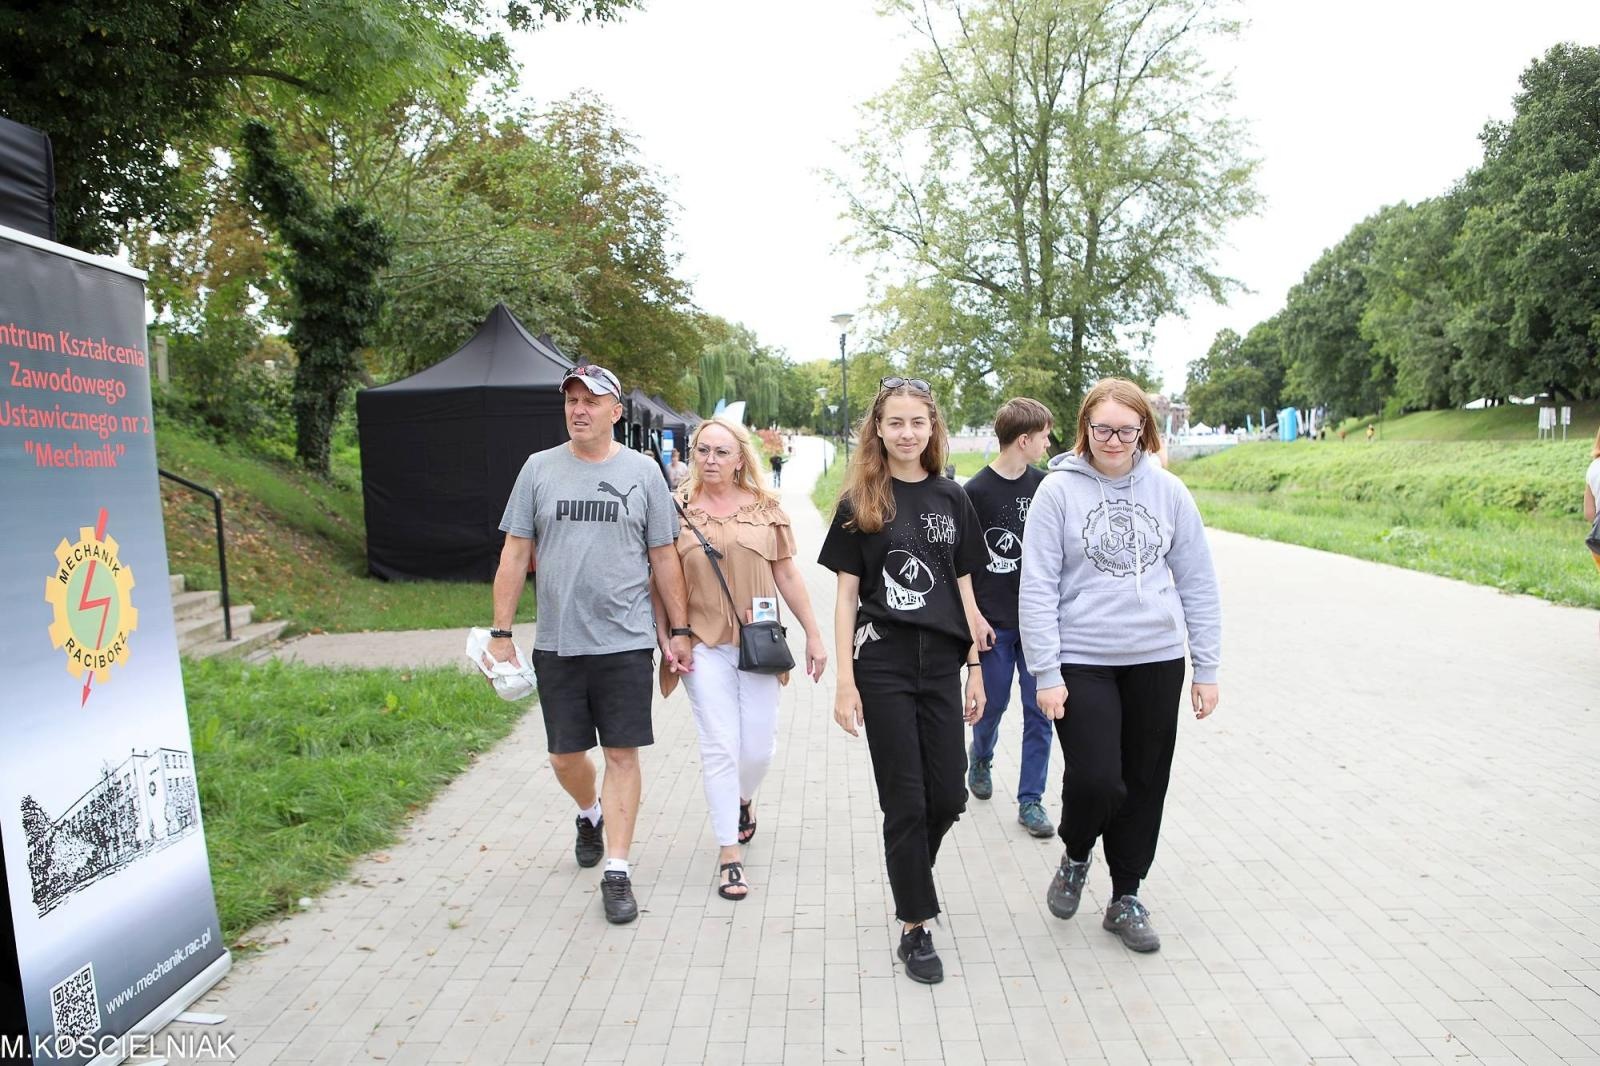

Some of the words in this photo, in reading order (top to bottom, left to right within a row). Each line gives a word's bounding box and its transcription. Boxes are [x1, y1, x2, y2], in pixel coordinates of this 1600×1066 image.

[59, 331, 145, 367] Kształcenia
[9, 361, 127, 405] Zawodowego
[0, 400, 118, 439] Ustawicznego
[122, 416, 138, 432] nr
[142, 416, 150, 434] 2
[556, 500, 619, 522] PUMA
[59, 543, 120, 584] MECHANIK
[1091, 545, 1132, 571] Politechniki
[65, 631, 127, 669] RACIBÓRZ
[105, 927, 212, 1015] www.mechanik.rac.pl
